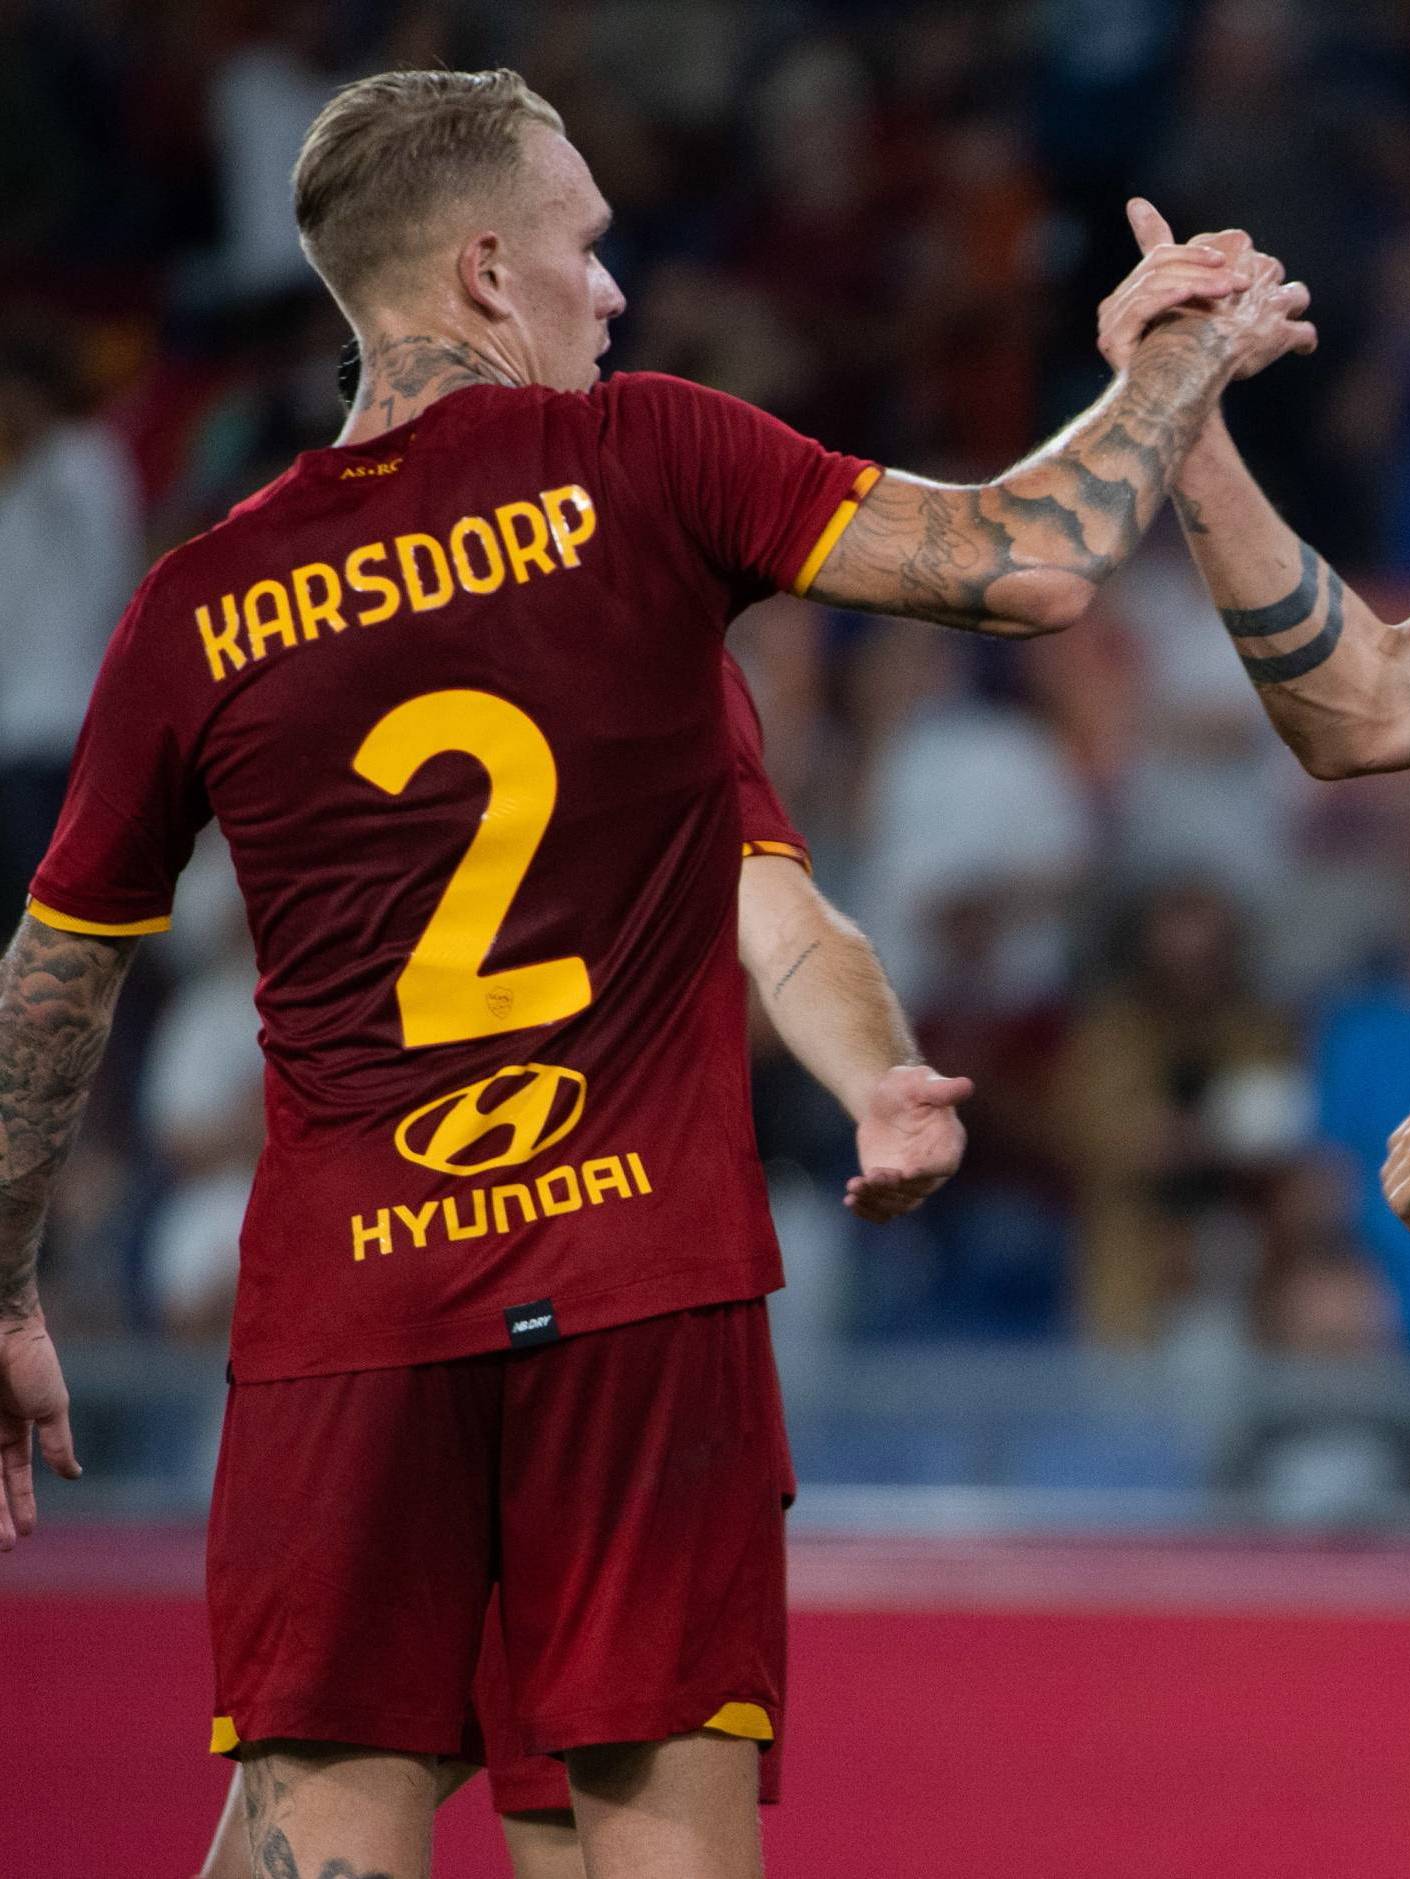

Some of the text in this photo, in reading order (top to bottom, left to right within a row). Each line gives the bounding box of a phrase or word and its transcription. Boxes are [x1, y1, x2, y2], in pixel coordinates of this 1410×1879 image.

[195, 484, 598, 682] KARSDORP
[352, 689, 592, 1049] 2
[351, 1151, 653, 1262] HYUNDAI
